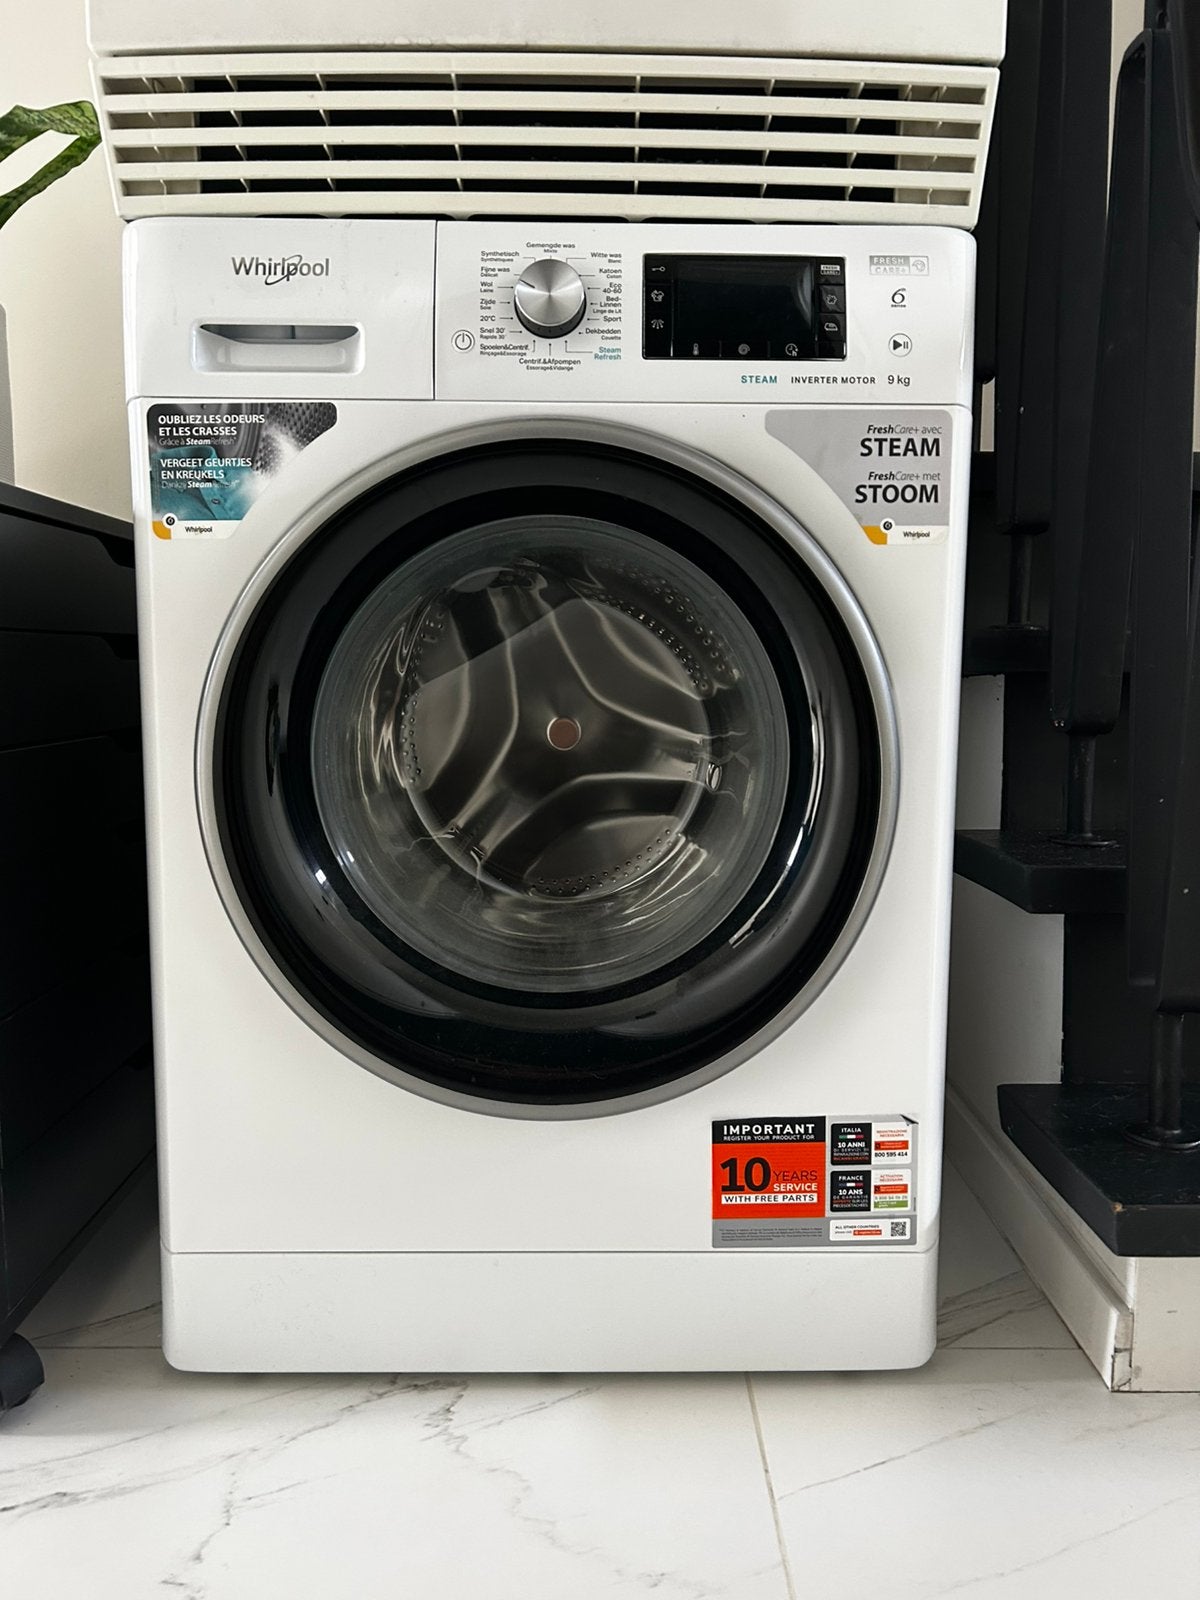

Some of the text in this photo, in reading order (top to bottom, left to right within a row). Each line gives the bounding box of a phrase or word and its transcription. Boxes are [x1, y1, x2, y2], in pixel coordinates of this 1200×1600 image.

[873, 257, 905, 265] FRESH
[231, 254, 330, 285] Whirlpool
[741, 374, 778, 384] STEAM
[791, 376, 876, 385] INVERTER MOTOR
[887, 374, 910, 388] 9 kg
[158, 414, 266, 424] OUBLIEZ LES ODEURS
[158, 426, 238, 436] ET LES CRASSES
[867, 424, 942, 434] FreshCare+ avec
[860, 437, 941, 457] STEAM
[160, 458, 252, 468] VERGEET GEURTJES
[161, 470, 224, 480] EN KREUKELS
[868, 471, 942, 481] FreshCare+ met
[854, 484, 939, 504] STOOM
[185, 526, 212, 534] Whirlpool
[903, 531, 930, 539] Whirlpool
[723, 1124, 816, 1136] IMPORTANT
[720, 1156, 772, 1193] 10
[773, 1170, 818, 1182] YEARS
[773, 1182, 818, 1192] SERVICE
[782, 1194, 815, 1202] PARTS
